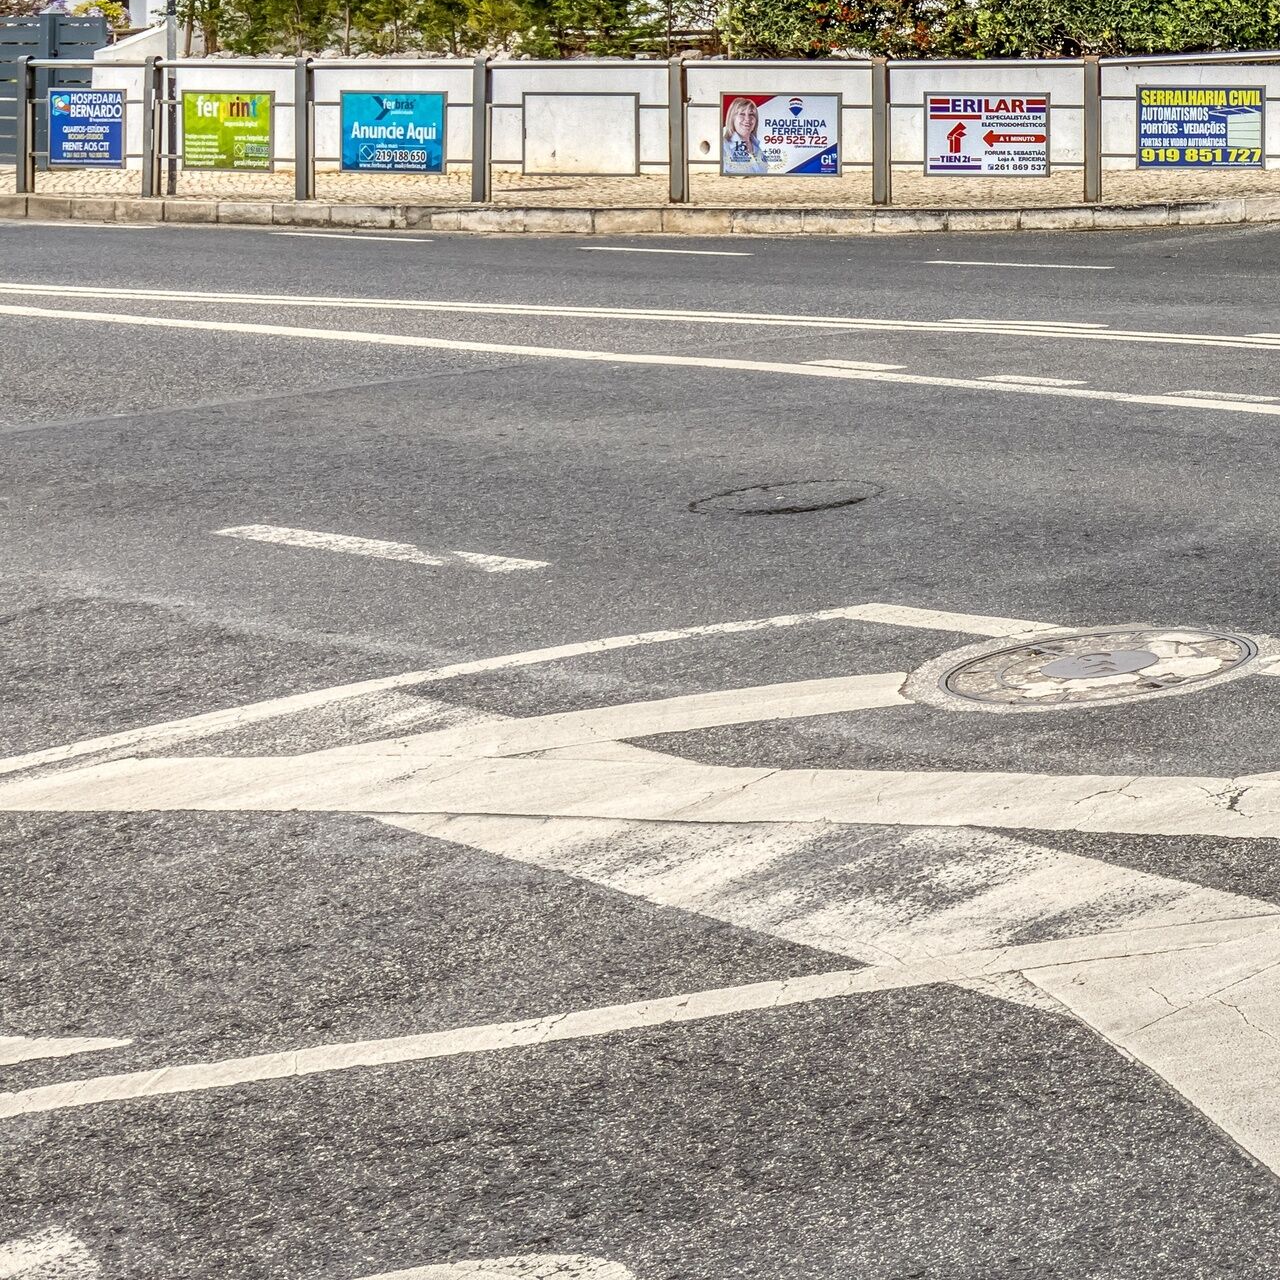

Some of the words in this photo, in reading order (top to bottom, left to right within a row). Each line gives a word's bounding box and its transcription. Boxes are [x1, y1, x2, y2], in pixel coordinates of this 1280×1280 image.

[70, 94, 122, 104] HOSPEDARIA
[1141, 90, 1227, 106] SERRALHARIA
[1229, 90, 1262, 106] CIVIL
[70, 105, 122, 117] BERNARDO
[196, 96, 257, 122] ferprint
[951, 99, 1025, 112] ERILAR
[1141, 107, 1209, 121] AUTOMATISMOS
[764, 119, 827, 128] RAQUELINDA
[1141, 121, 1178, 134] PORTÕES
[1183, 121, 1226, 136] VEDAÇÕES
[351, 121, 404, 139] Anuncie
[406, 122, 436, 144] Aqui
[62, 142, 83, 150] FRENTE
[83, 142, 97, 150] AOS
[98, 142, 110, 150] CTT
[734, 141, 748, 151] 15
[764, 136, 784, 144] 969
[786, 136, 806, 144] 525
[808, 136, 828, 144] 722
[1141, 138, 1162, 146] PORTAS
[1162, 138, 1170, 146] DE
[1170, 138, 1187, 146] VIDRO
[1187, 136, 1227, 147] AUTOMÁTICAS
[375, 150, 392, 162] 219
[393, 150, 409, 162] 188
[410, 150, 427, 162] 650
[1141, 148, 1180, 162] 919
[1185, 148, 1222, 162] 851
[1227, 148, 1262, 162] 727
